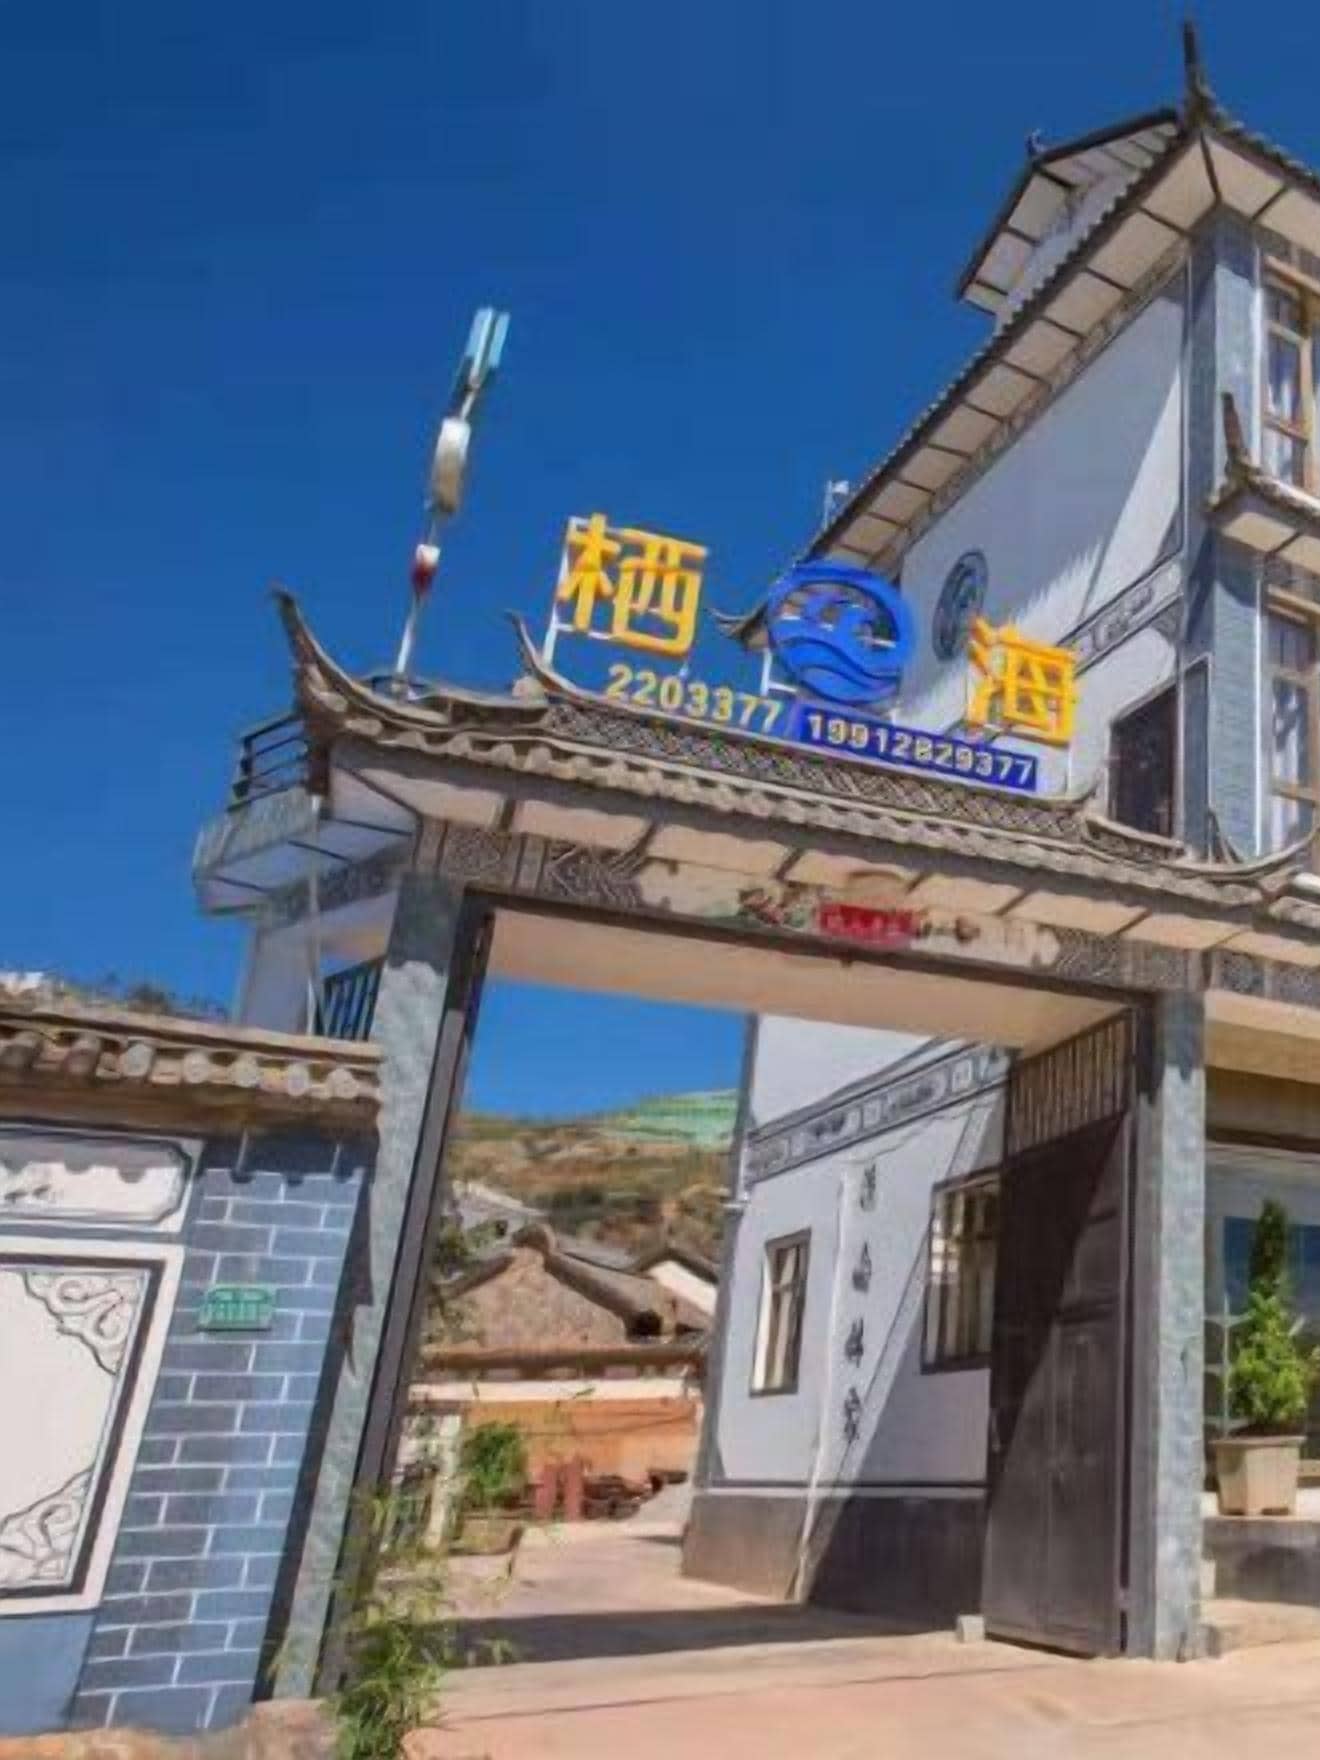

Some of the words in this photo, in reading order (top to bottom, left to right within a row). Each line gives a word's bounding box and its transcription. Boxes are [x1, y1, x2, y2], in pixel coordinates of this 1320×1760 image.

[557, 513, 707, 657] 栖
[606, 663, 784, 734] 2203377
[808, 714, 1034, 785] 19912829377
